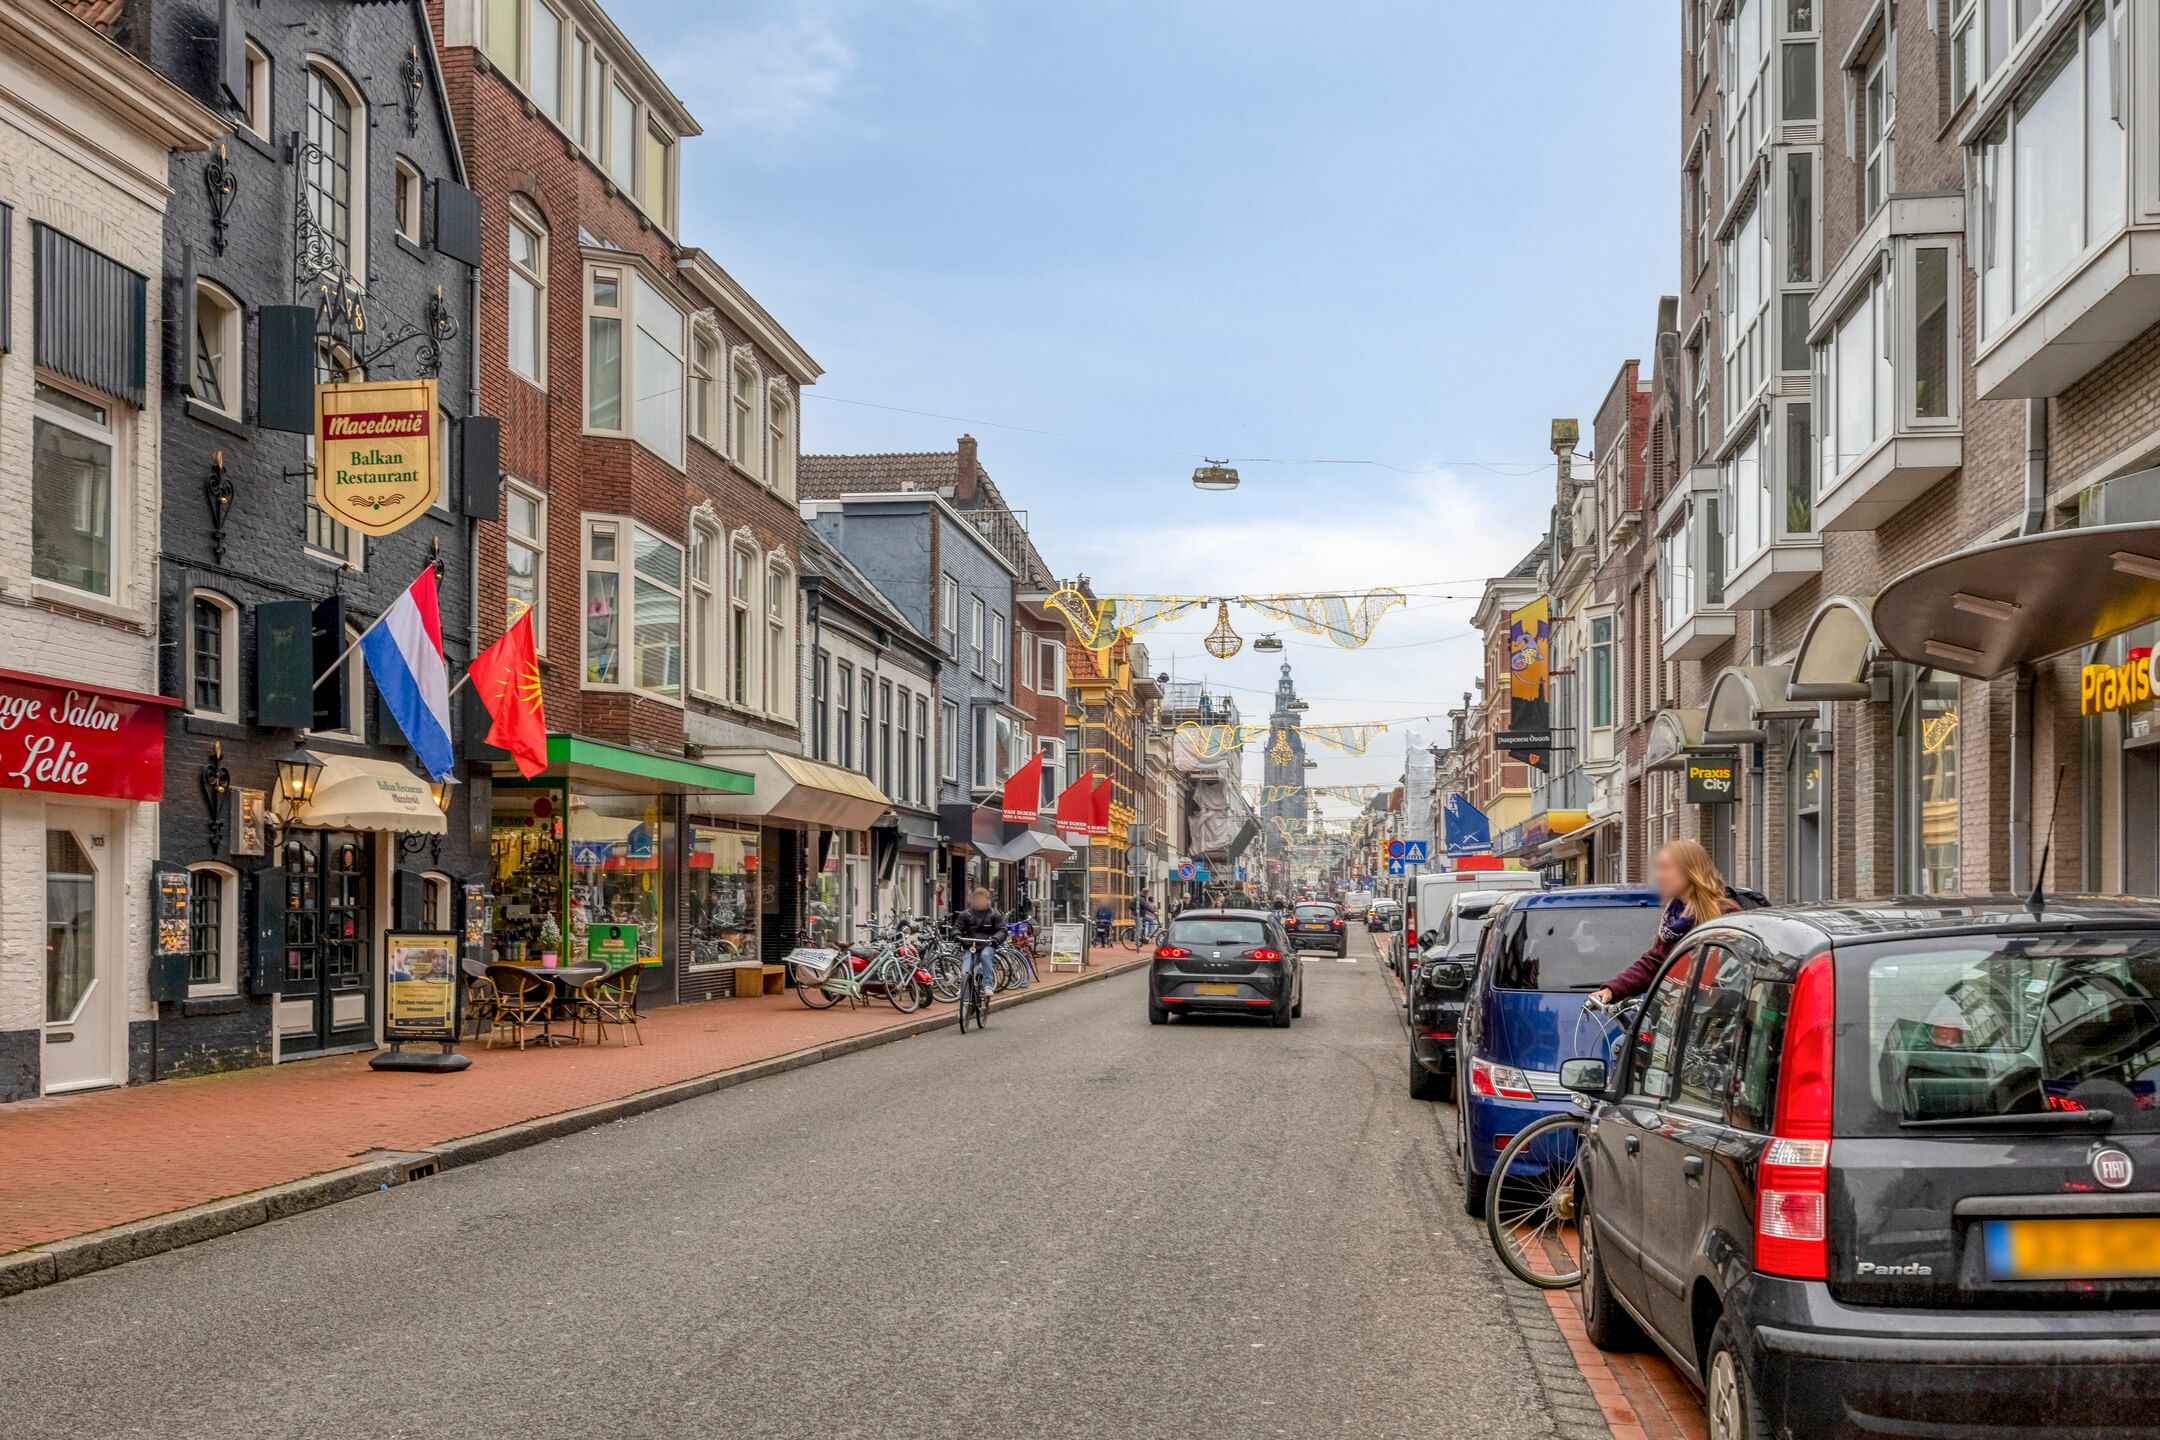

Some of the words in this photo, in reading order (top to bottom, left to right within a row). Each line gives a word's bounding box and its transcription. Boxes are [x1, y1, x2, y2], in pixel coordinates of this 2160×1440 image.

[328, 414, 423, 436] Macedonië
[350, 449, 403, 466] Balkan
[336, 470, 418, 485] Restaurant
[2081, 650, 2150, 716] Praxis
[50, 689, 119, 731] Salon
[8, 734, 89, 788] Lelie
[1690, 767, 1731, 779] Praxis
[1703, 778, 1731, 792] City
[2101, 1161, 2125, 1179] FIAT
[1857, 1262, 1932, 1275] Panda
